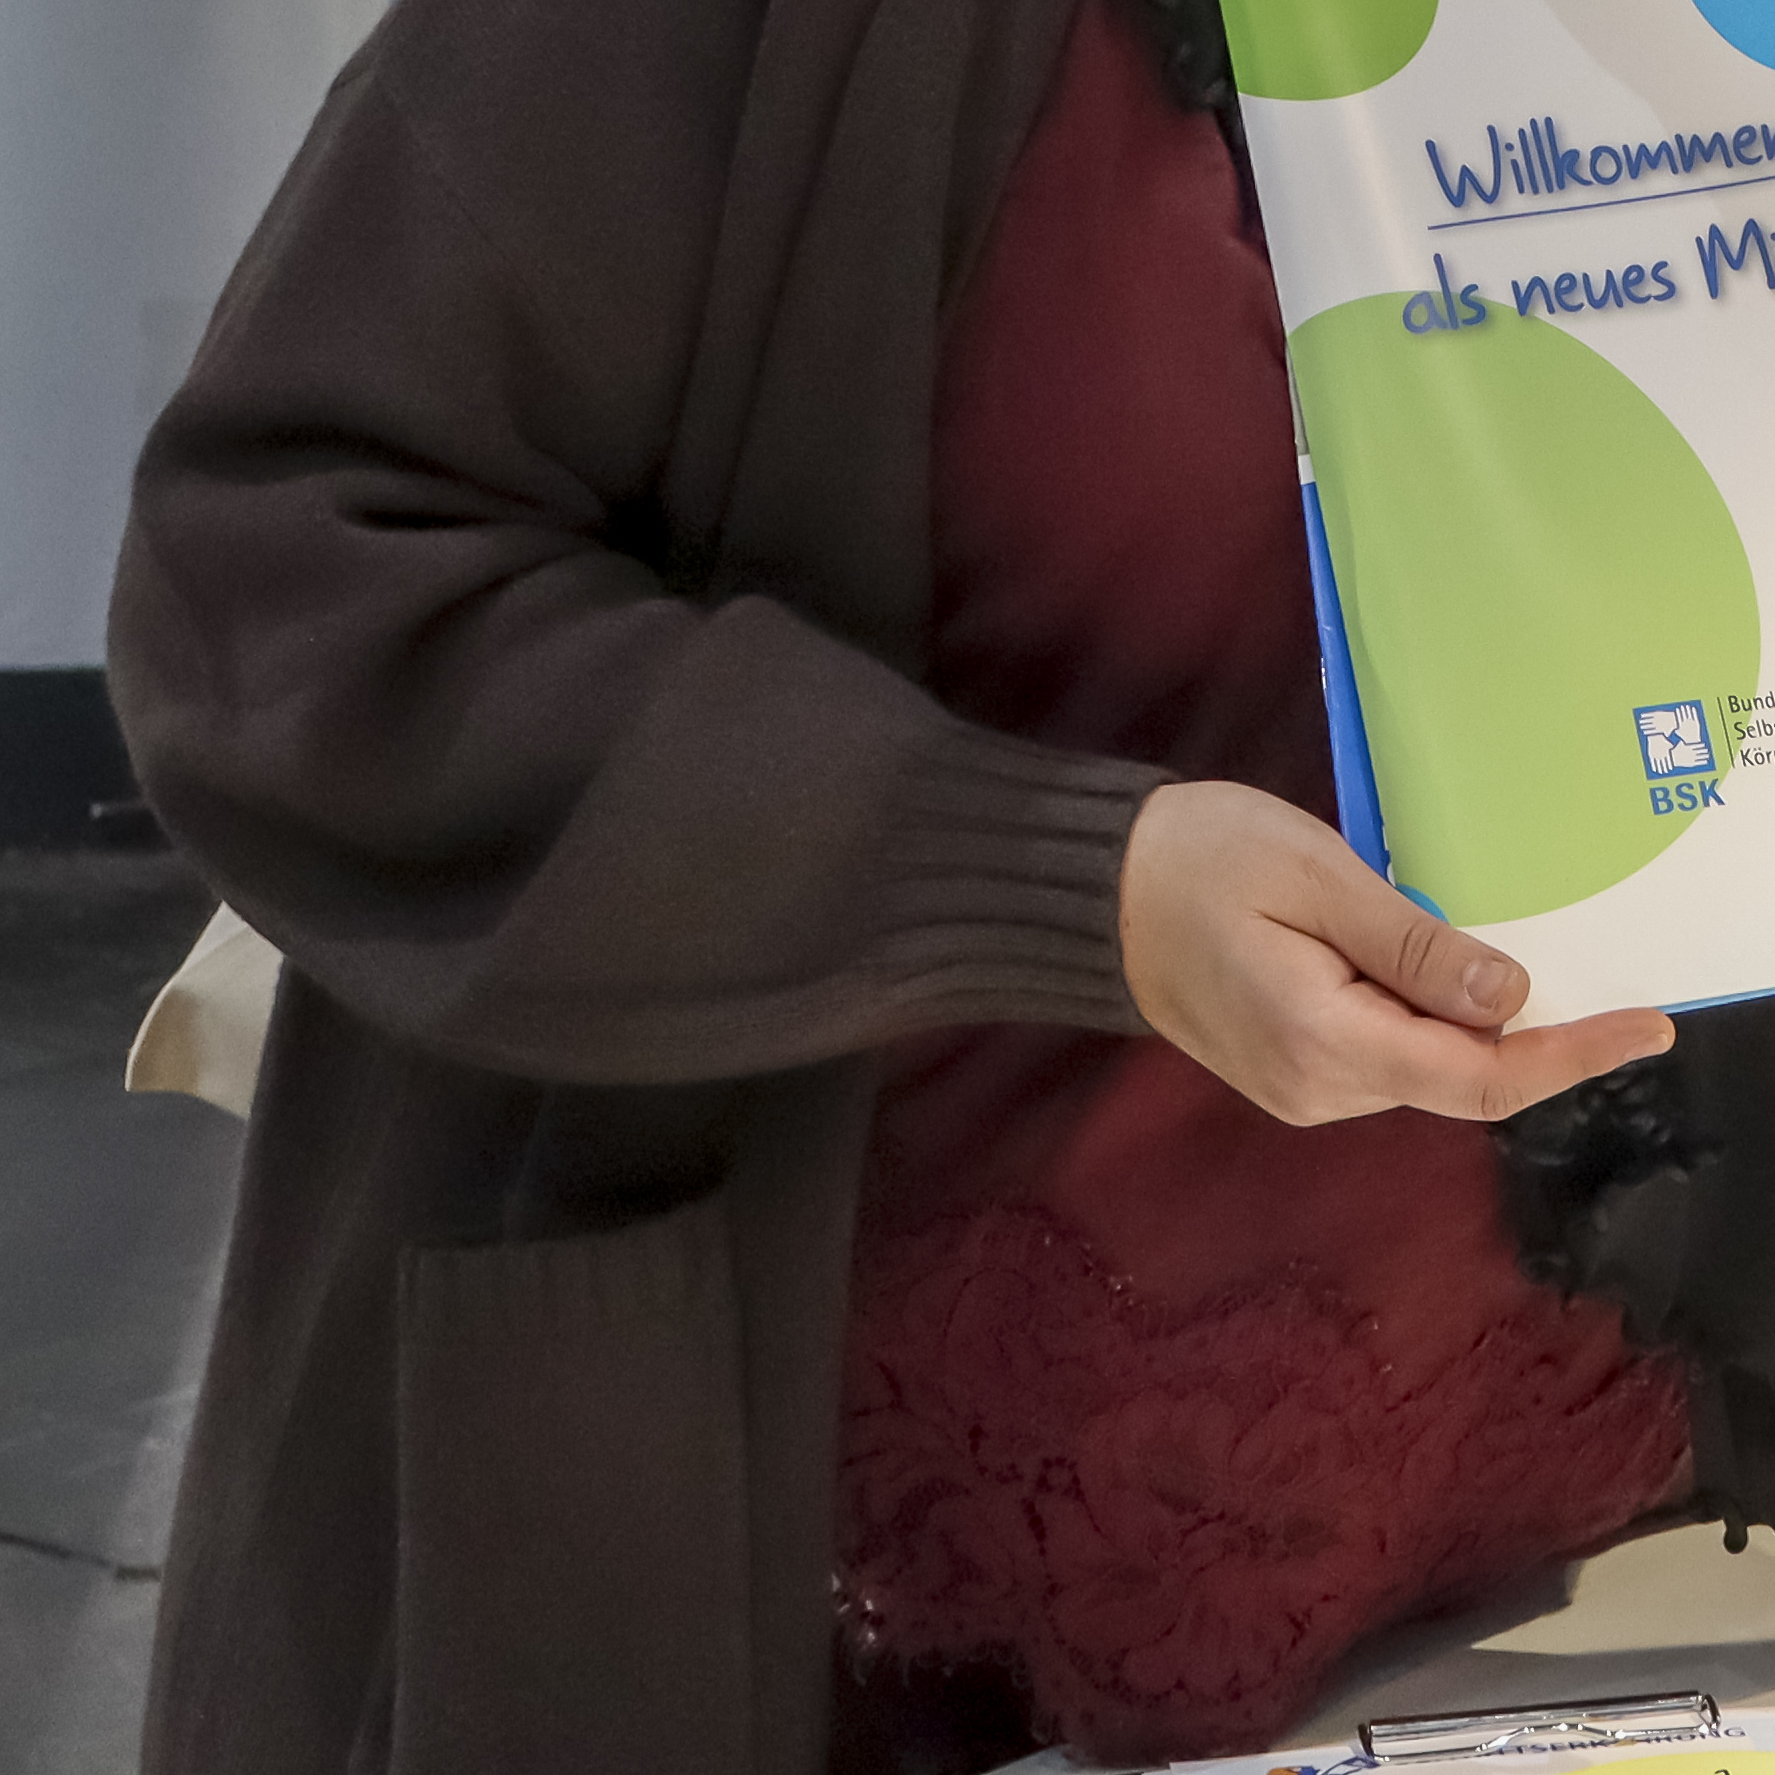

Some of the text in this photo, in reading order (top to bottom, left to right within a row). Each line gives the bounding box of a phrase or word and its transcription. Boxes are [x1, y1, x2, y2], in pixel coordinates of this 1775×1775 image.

[1402, 253, 1488, 335] als
[1511, 260, 1677, 317] neues
[1649, 777, 1726, 816] BSK
